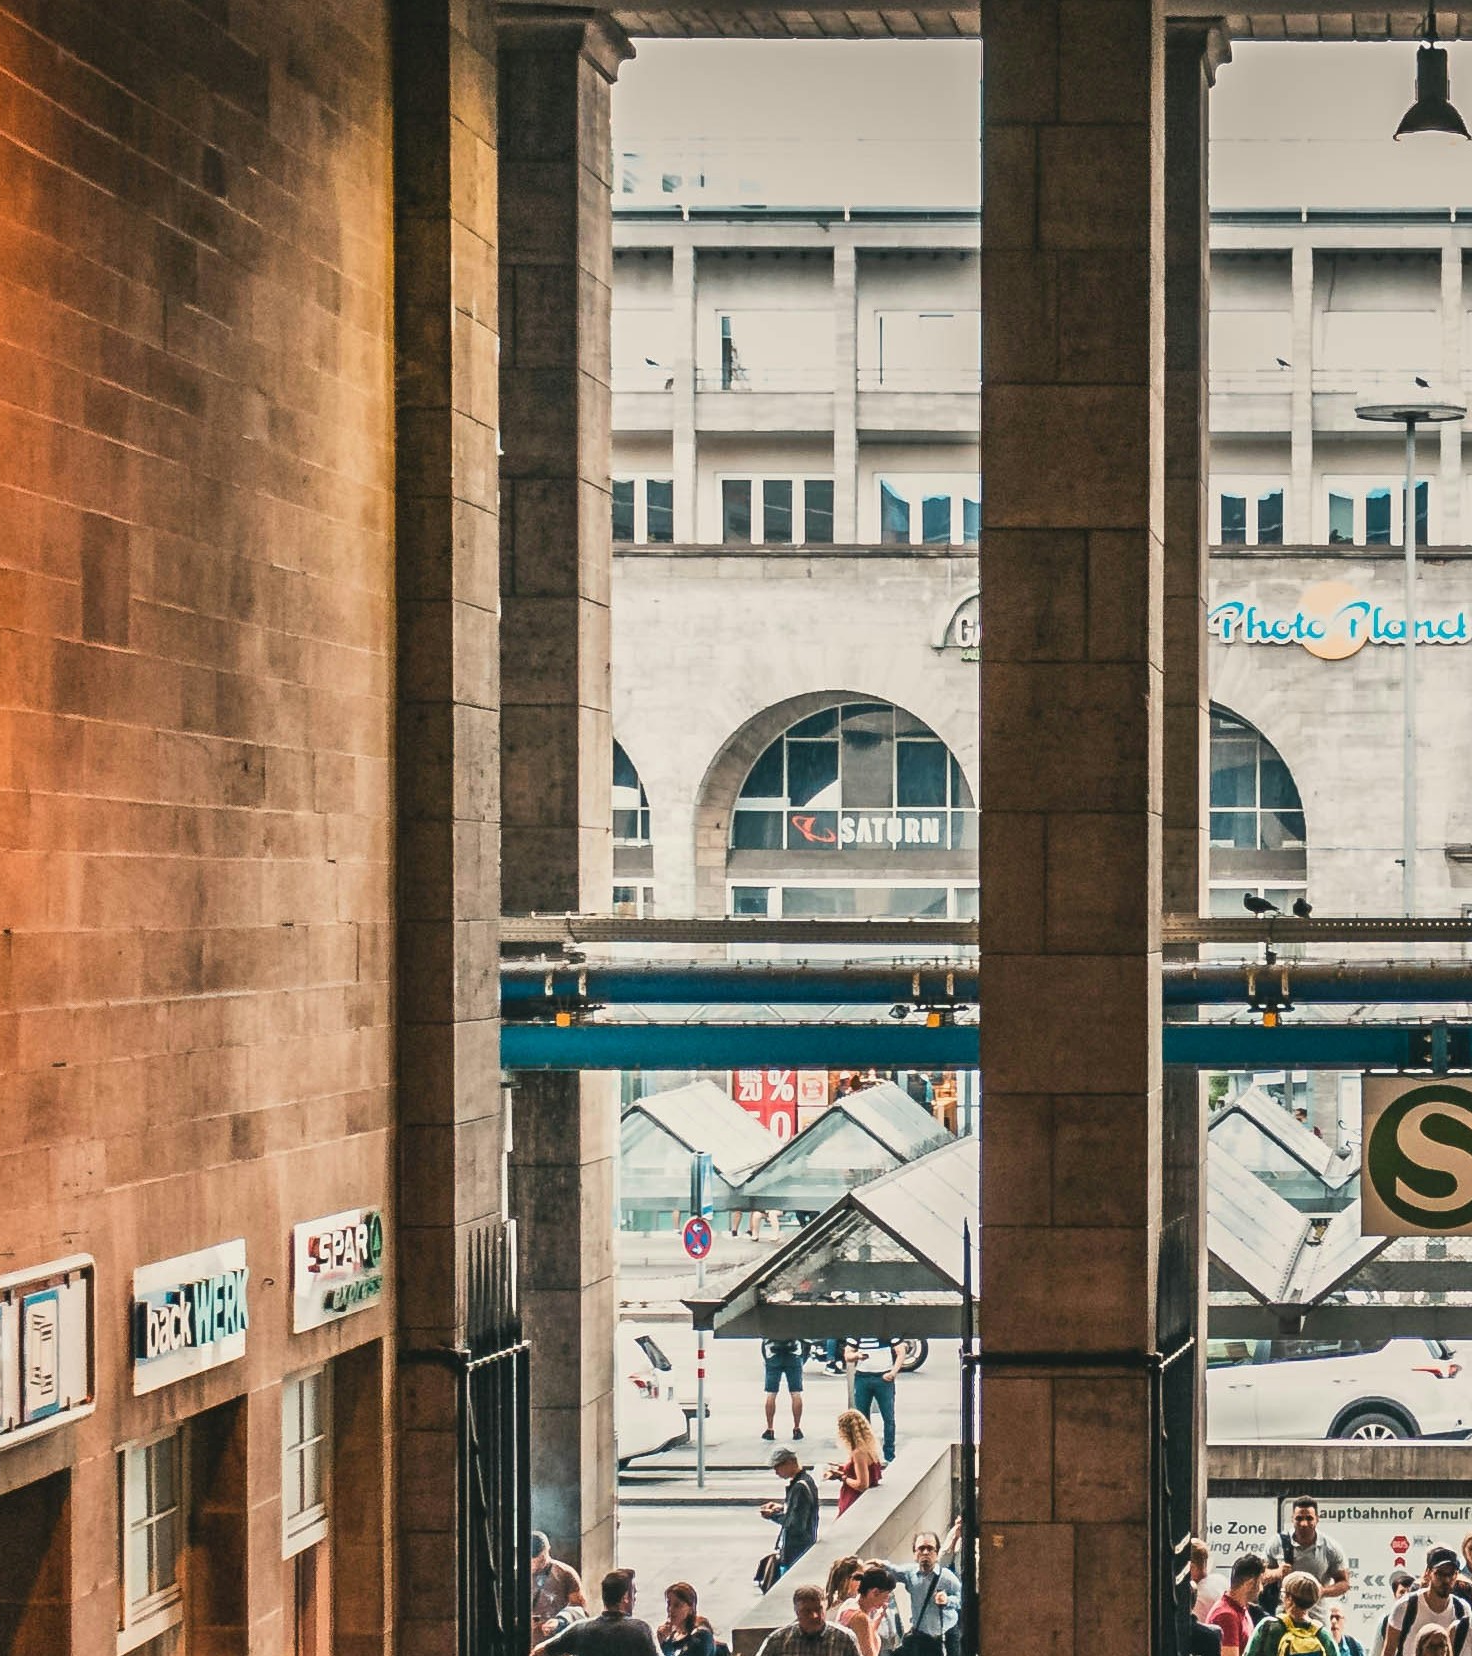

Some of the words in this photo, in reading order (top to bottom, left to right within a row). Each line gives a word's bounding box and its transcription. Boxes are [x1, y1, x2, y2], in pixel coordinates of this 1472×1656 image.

[1208, 601, 1326, 640] Photo
[840, 817, 940, 844] SATURN
[739, 1082, 763, 1102] ZU
[309, 1222, 369, 1274] SPAR
[1319, 1507, 1415, 1522] auptbahnhof
[1228, 1521, 1267, 1535] Zone
